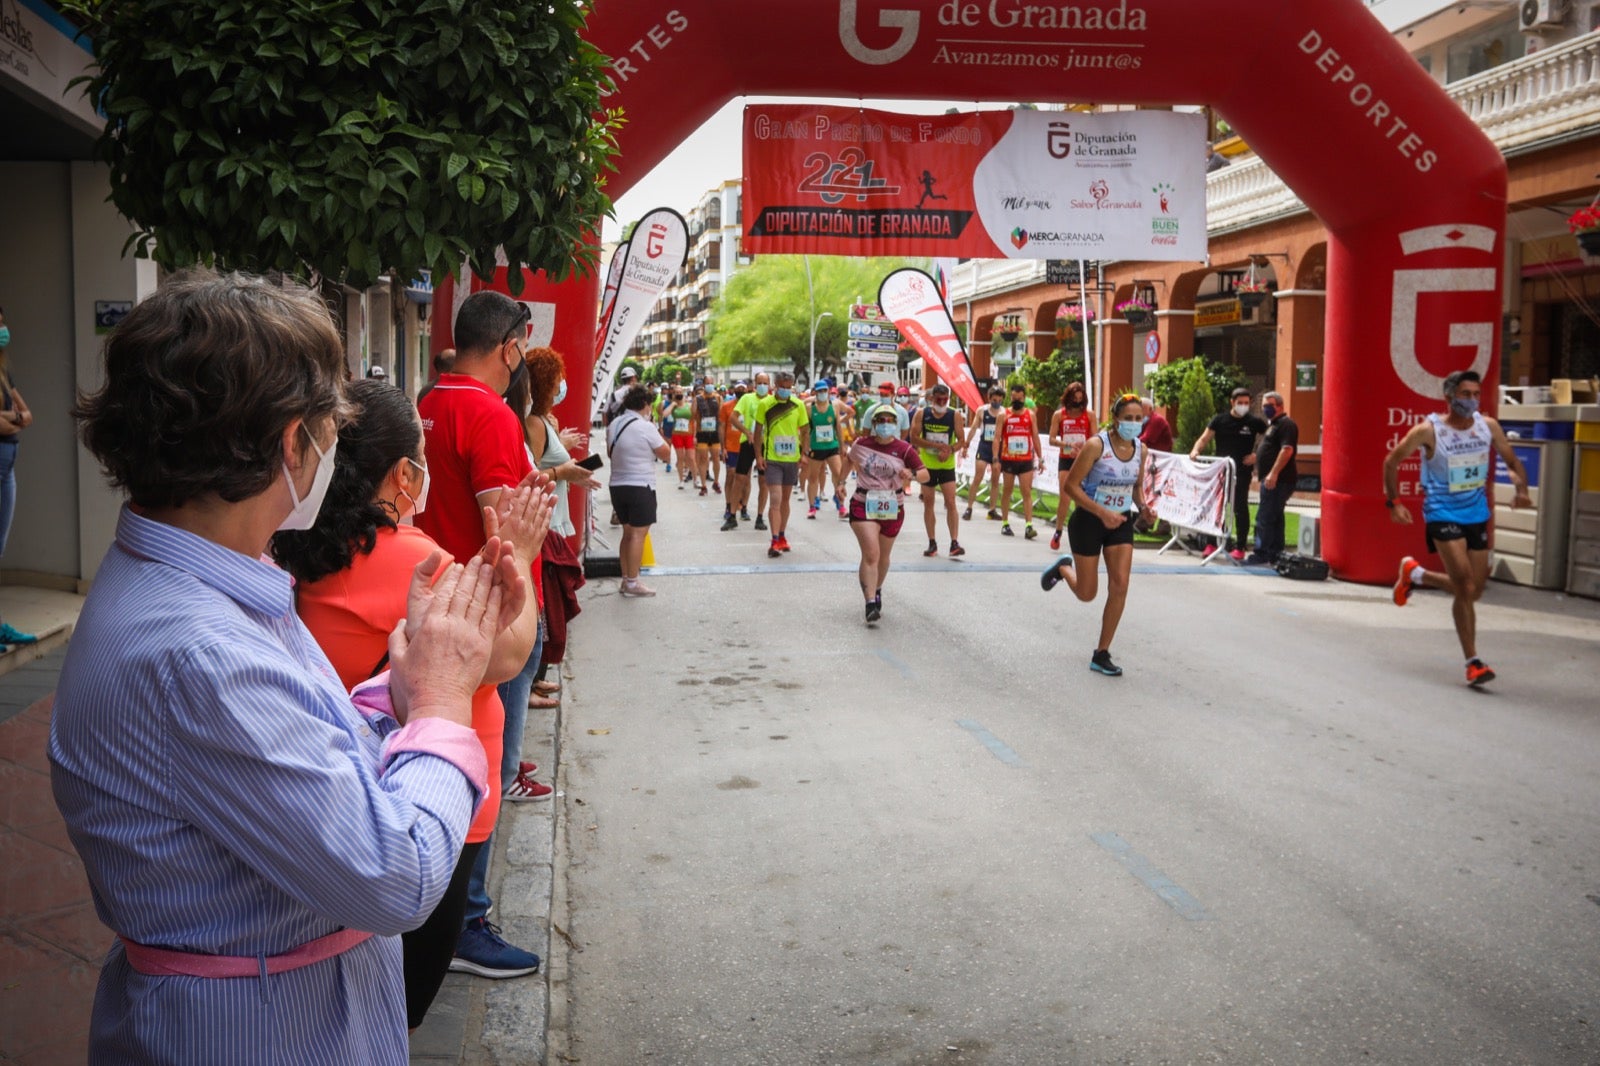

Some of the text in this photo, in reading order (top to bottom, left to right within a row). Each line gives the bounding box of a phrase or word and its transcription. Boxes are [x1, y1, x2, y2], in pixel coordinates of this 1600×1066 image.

[937, 0, 1148, 31] de Granada
[932, 45, 1143, 71] Avanzamos junt@s
[1297, 29, 1438, 173] DEPORTES
[754, 114, 982, 145] GRAN PREMIO DE FONDO
[1074, 131, 1137, 144] Diputación
[1074, 144, 1137, 156] de Granada
[1101, 199, 1142, 210] Granada
[765, 209, 952, 236] DIPUTACIÓN DE GRANADA
[1152, 221, 1179, 230] BUEN
[1028, 231, 1105, 242] MERCAGRANADA
[630, 255, 670, 276] Diputación
[633, 270, 665, 288] Granada
[780, 442, 793, 451] 151
[1464, 467, 1479, 480] 24
[877, 501, 890, 511] 26
[1103, 495, 1125, 507] 215
